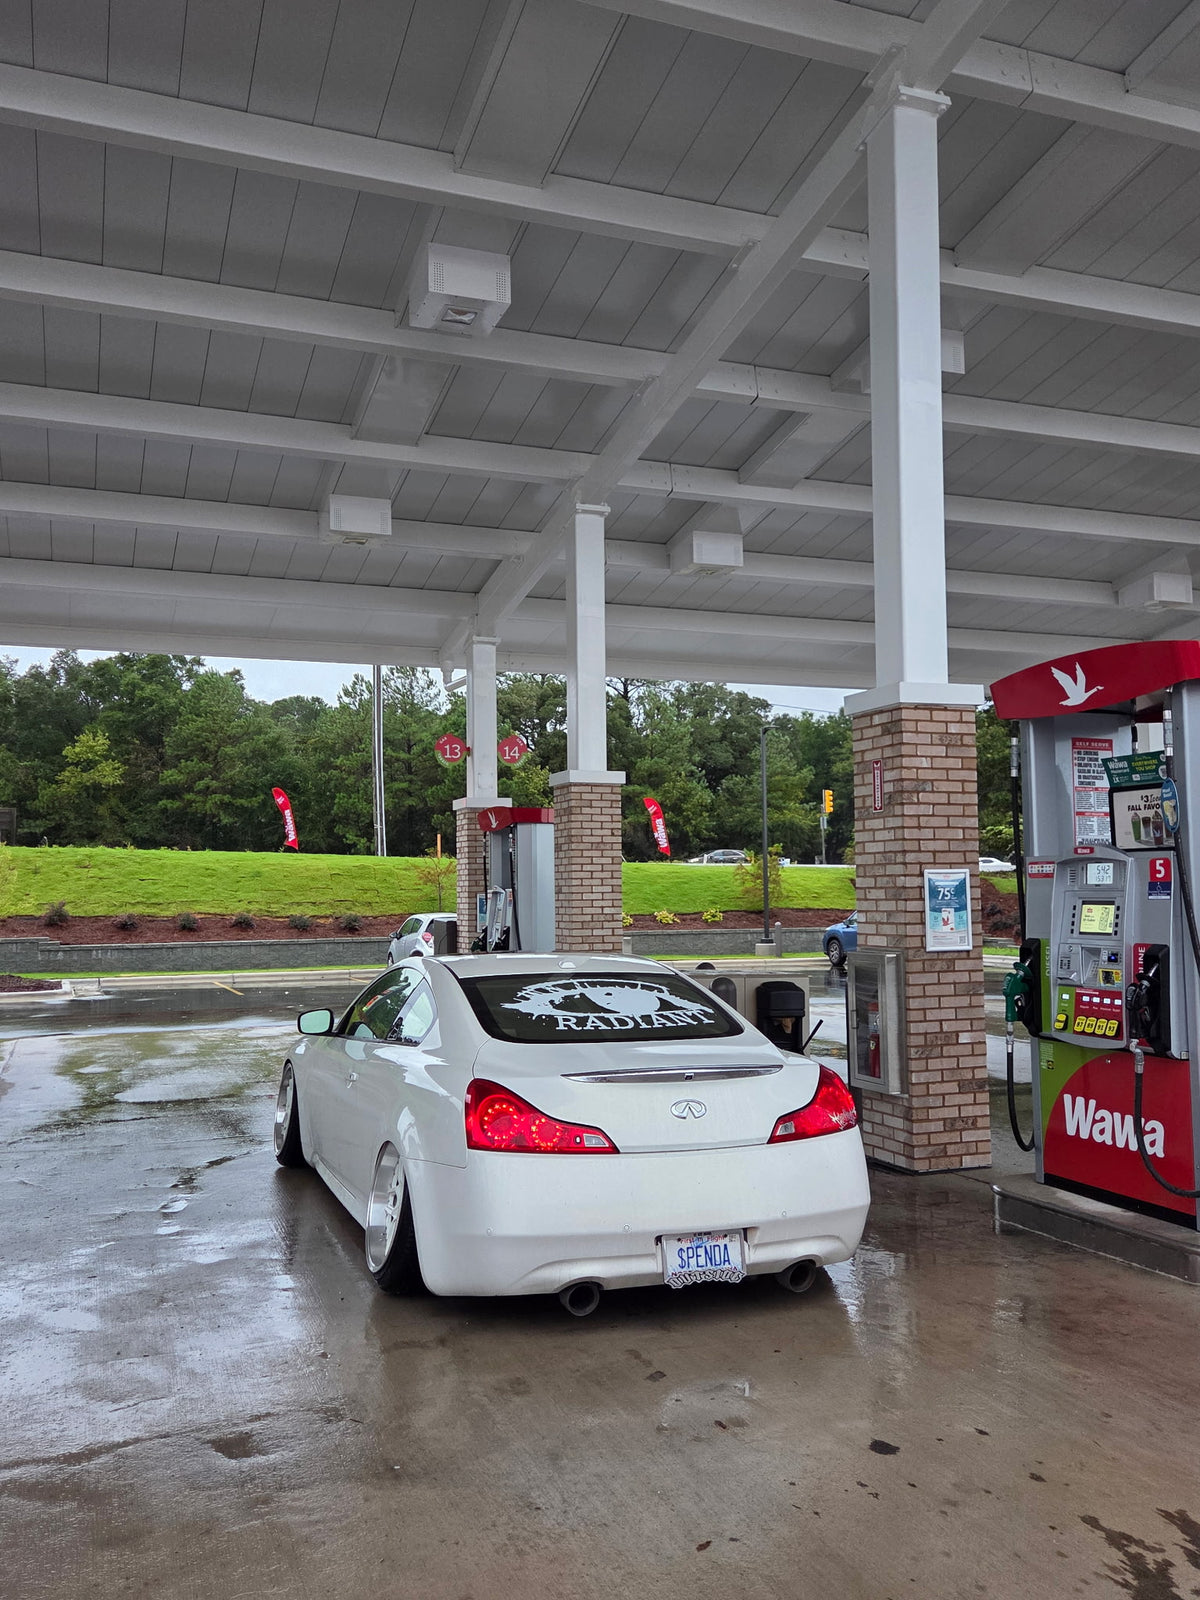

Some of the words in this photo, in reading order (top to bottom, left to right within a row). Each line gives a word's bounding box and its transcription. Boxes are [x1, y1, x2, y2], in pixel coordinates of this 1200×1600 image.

[444, 744, 461, 759] 13
[503, 746, 520, 760] 14
[1107, 761, 1128, 770] Wawa
[1127, 804, 1142, 812] FALL
[1143, 803, 1161, 811] FAVO
[1155, 859, 1165, 878] 5
[555, 1009, 715, 1031] RADIANT
[1063, 1093, 1165, 1158] Wawa
[677, 1243, 731, 1269] $PENDA
